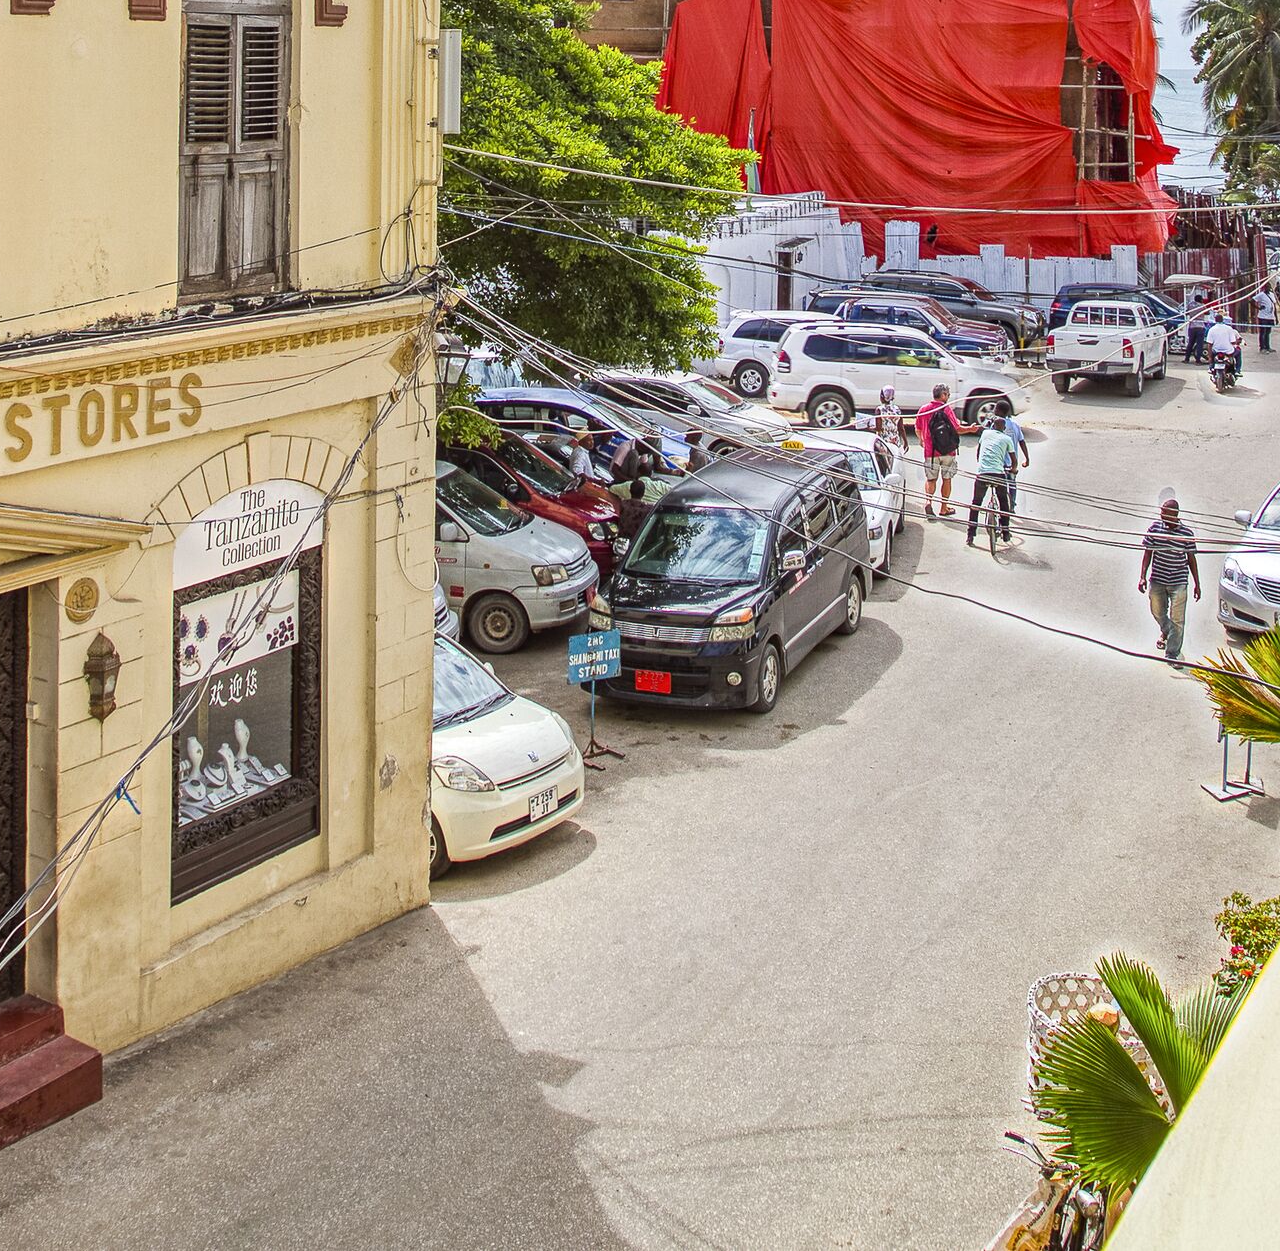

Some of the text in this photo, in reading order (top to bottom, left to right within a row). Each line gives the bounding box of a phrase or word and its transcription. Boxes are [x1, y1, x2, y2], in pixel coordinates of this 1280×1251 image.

[4, 371, 204, 463] STORES
[784, 441, 800, 449] TAXI
[240, 489, 266, 513] The
[204, 499, 300, 552] Tanzanite
[222, 534, 281, 567] Collection
[604, 648, 620, 661] TAXI
[578, 664, 608, 678] STAND
[208, 667, 258, 707] 欢迎您
